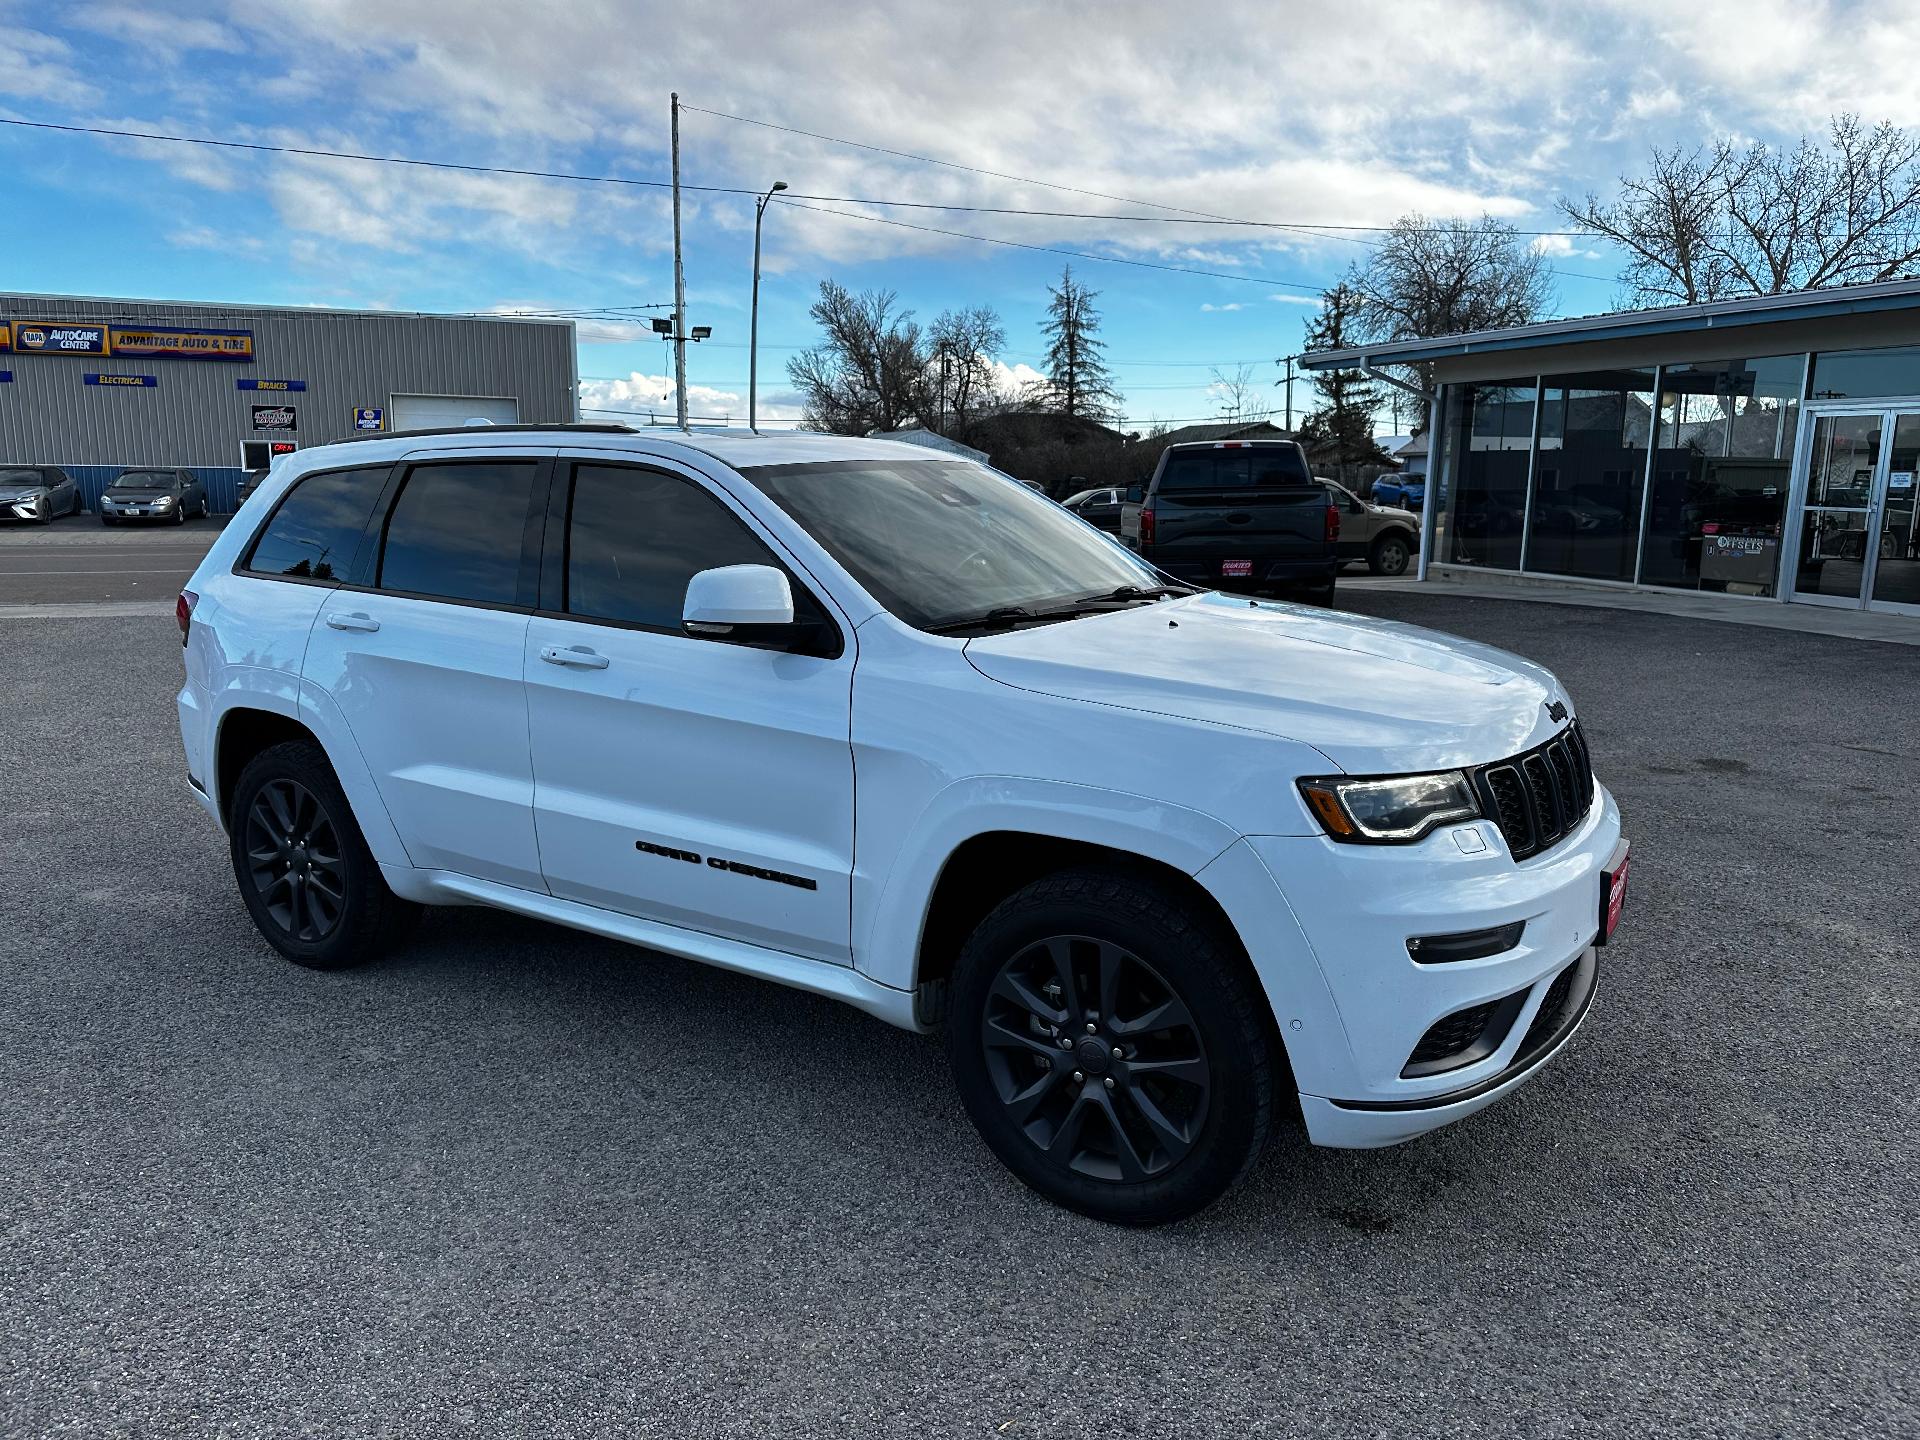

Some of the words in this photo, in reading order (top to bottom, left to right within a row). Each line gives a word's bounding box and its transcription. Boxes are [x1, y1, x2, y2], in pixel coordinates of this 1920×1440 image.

[25, 332, 44, 343] NAPA
[119, 335, 178, 348] ADVANTAGE
[182, 338, 208, 349] AUTO
[212, 340, 219, 350] &
[223, 340, 244, 350] TIRE
[60, 340, 90, 350] CENTER
[99, 375, 143, 385] ELECTRICAL
[257, 380, 288, 390] BRAKES
